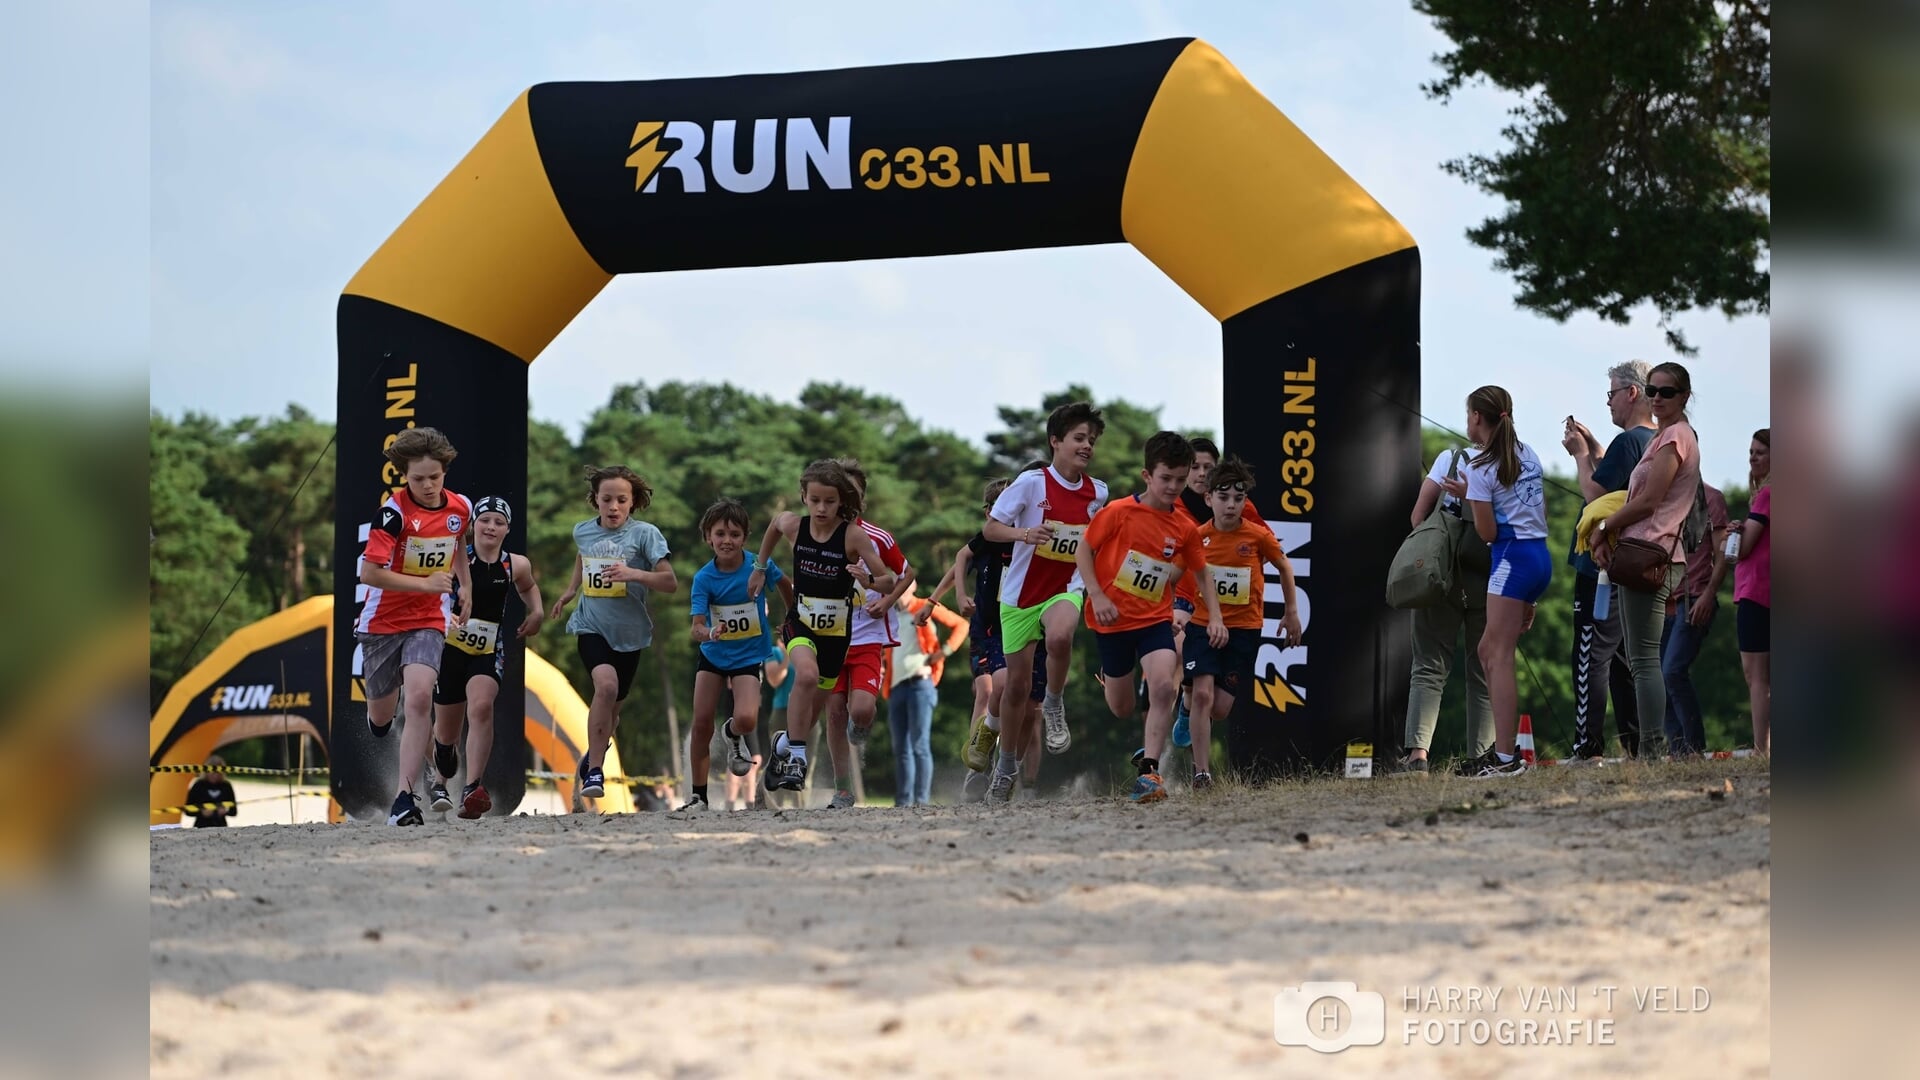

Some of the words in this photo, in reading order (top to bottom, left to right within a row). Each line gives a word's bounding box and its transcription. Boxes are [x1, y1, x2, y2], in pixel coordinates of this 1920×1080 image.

[625, 116, 853, 194] RUN
[1051, 537, 1078, 555] 160
[418, 552, 446, 568] 162
[800, 559, 840, 577] HELLAS
[1132, 569, 1159, 592] 161
[809, 613, 836, 629] 165
[456, 629, 487, 650] 399
